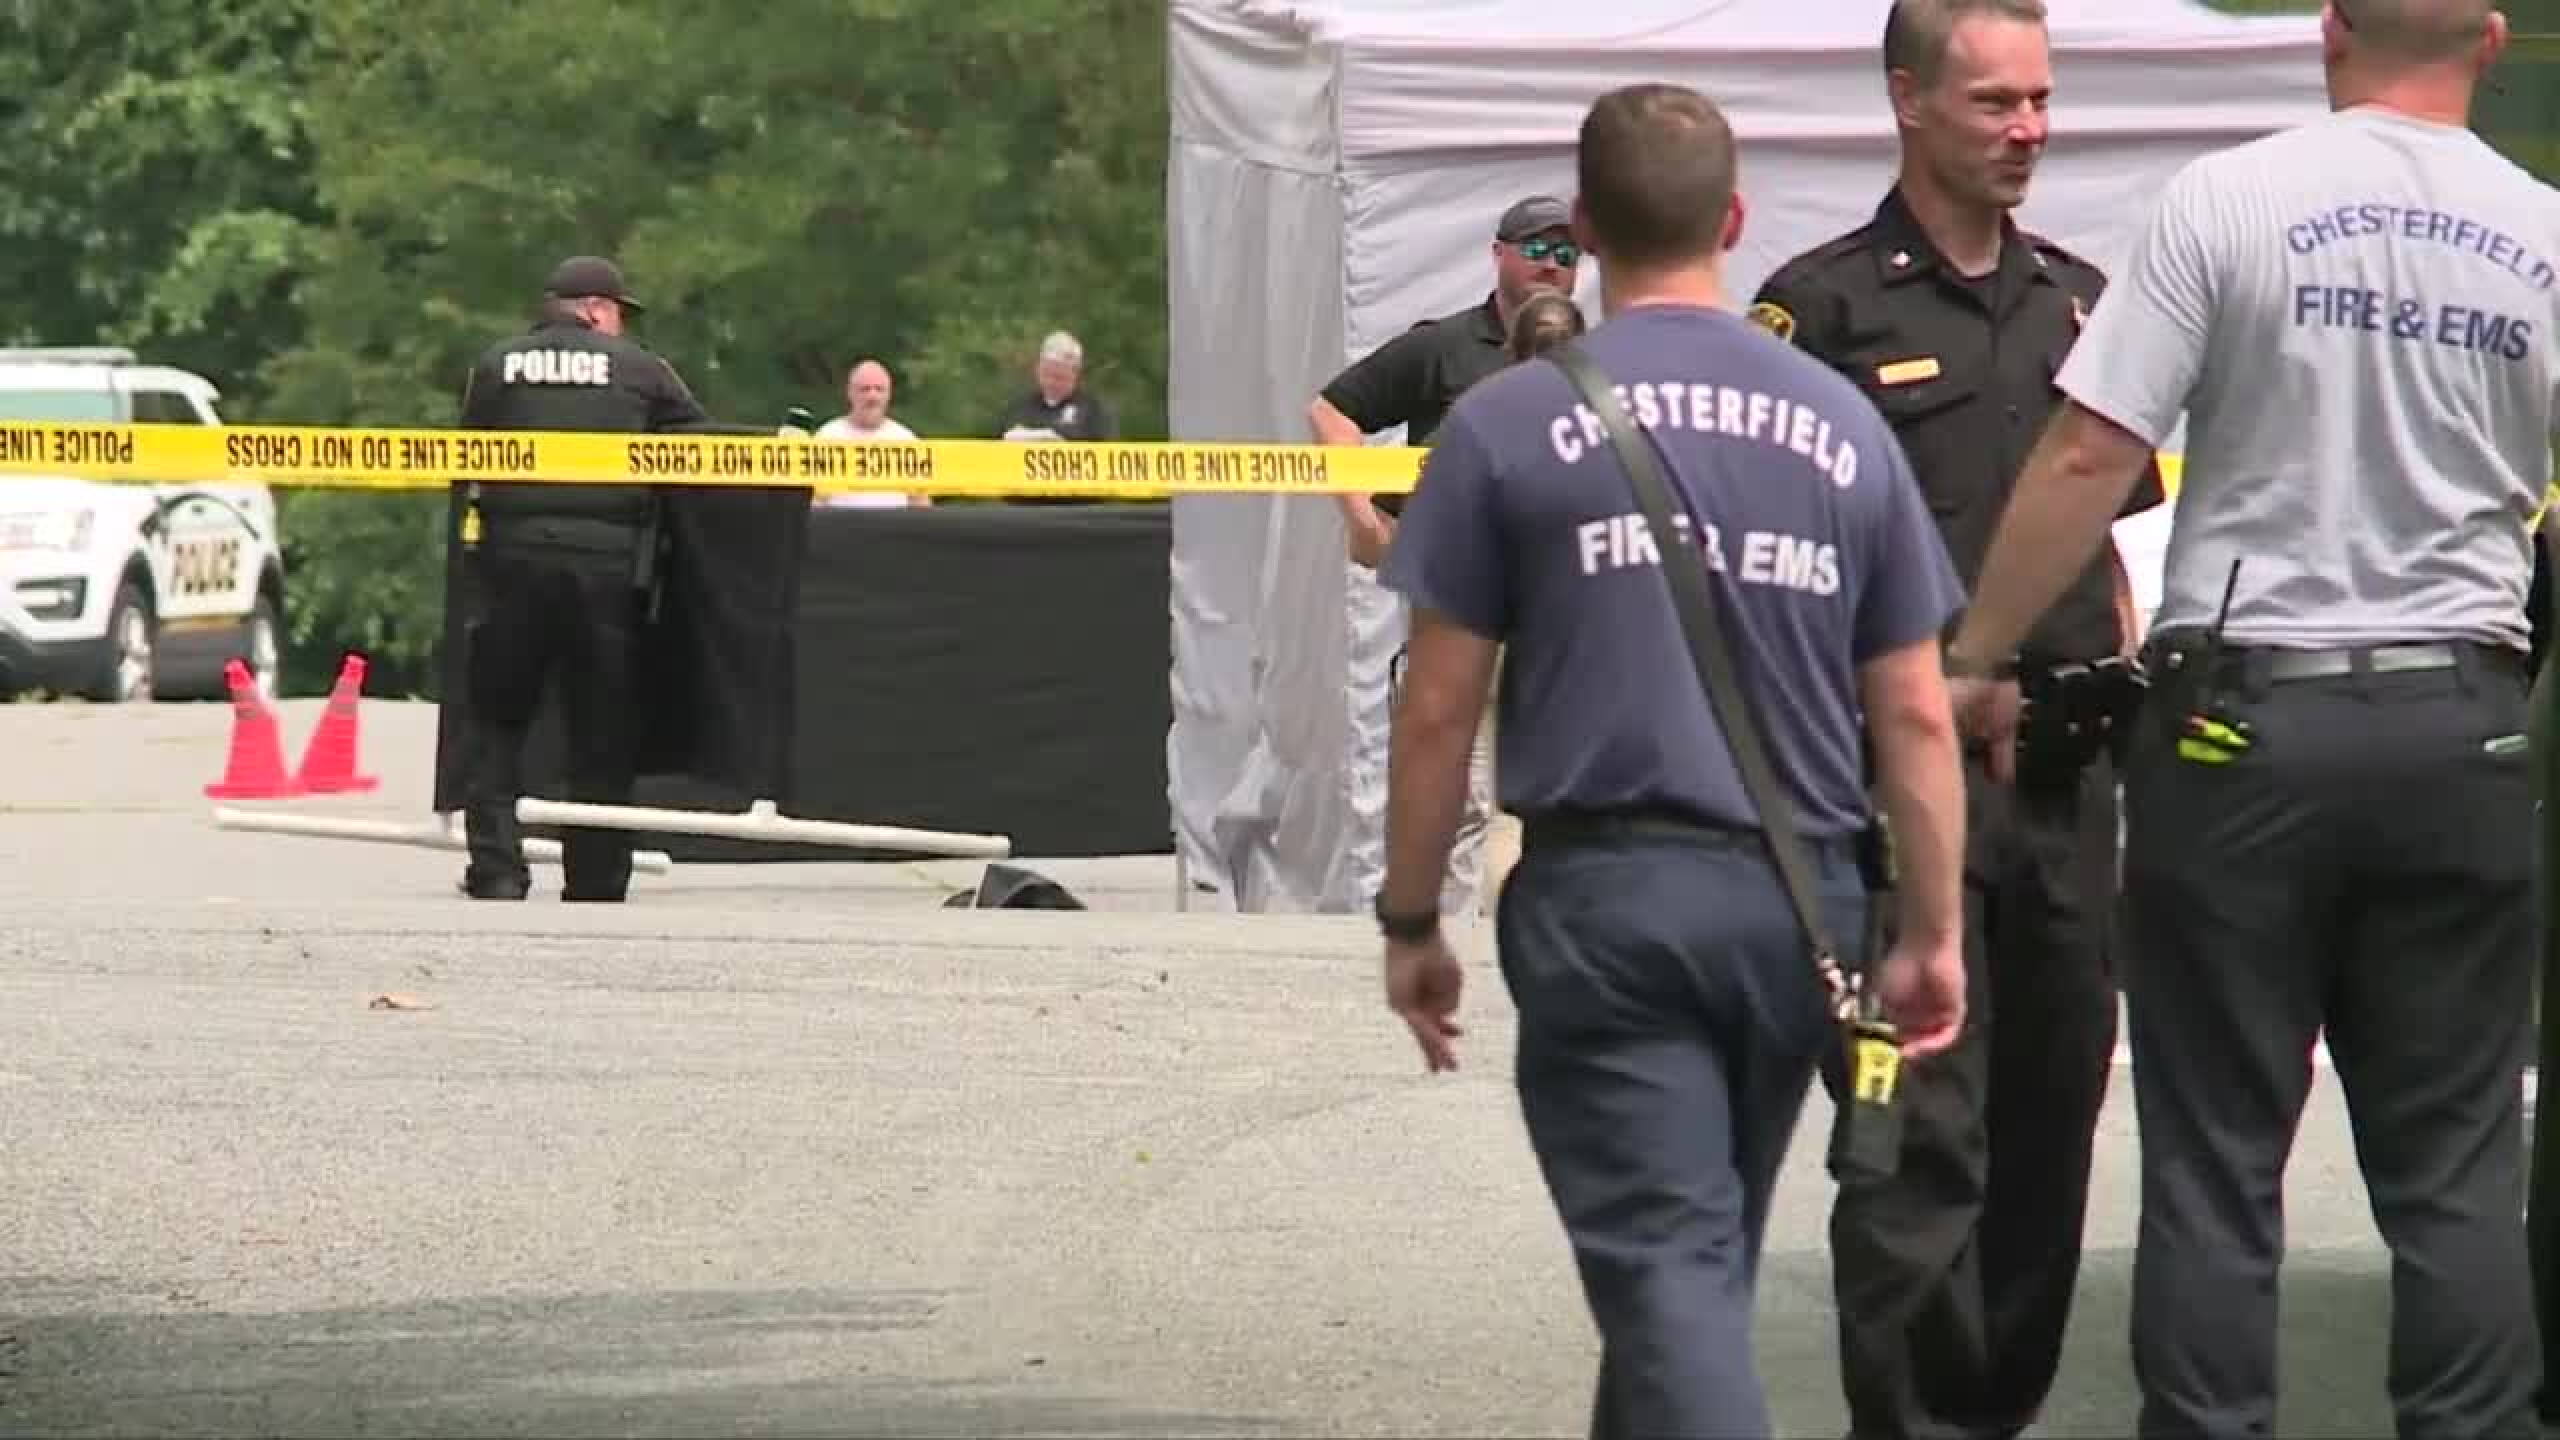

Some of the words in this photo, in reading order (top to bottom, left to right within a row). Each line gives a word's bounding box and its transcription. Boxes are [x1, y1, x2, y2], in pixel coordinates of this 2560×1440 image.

[2287, 204, 2556, 290] CHESTERFIELD
[2295, 285, 2384, 330] FIRE
[2391, 300, 2426, 339] &
[2436, 303, 2533, 361] EMS
[503, 349, 610, 384] POLICE
[0, 427, 45, 463] LINE
[53, 430, 134, 464] POLICE
[226, 433, 302, 467] CROSS
[311, 434, 353, 468] NOT
[361, 435, 391, 469] DO
[399, 436, 448, 470] LINE
[455, 437, 536, 472] POLICE
[627, 441, 702, 474] CROSS
[711, 443, 753, 476] NOT
[761, 443, 791, 477] DO
[799, 444, 847, 477] LINE
[855, 445, 933, 480] POLICE
[1023, 448, 1098, 481] CROSS
[1107, 449, 1148, 481] NOT
[1157, 449, 1186, 481] DO
[1193, 450, 1242, 482] LINE
[1249, 450, 1328, 483] POLICE
[1577, 513, 1690, 577] FIR
[1740, 531, 1840, 595] EMS
